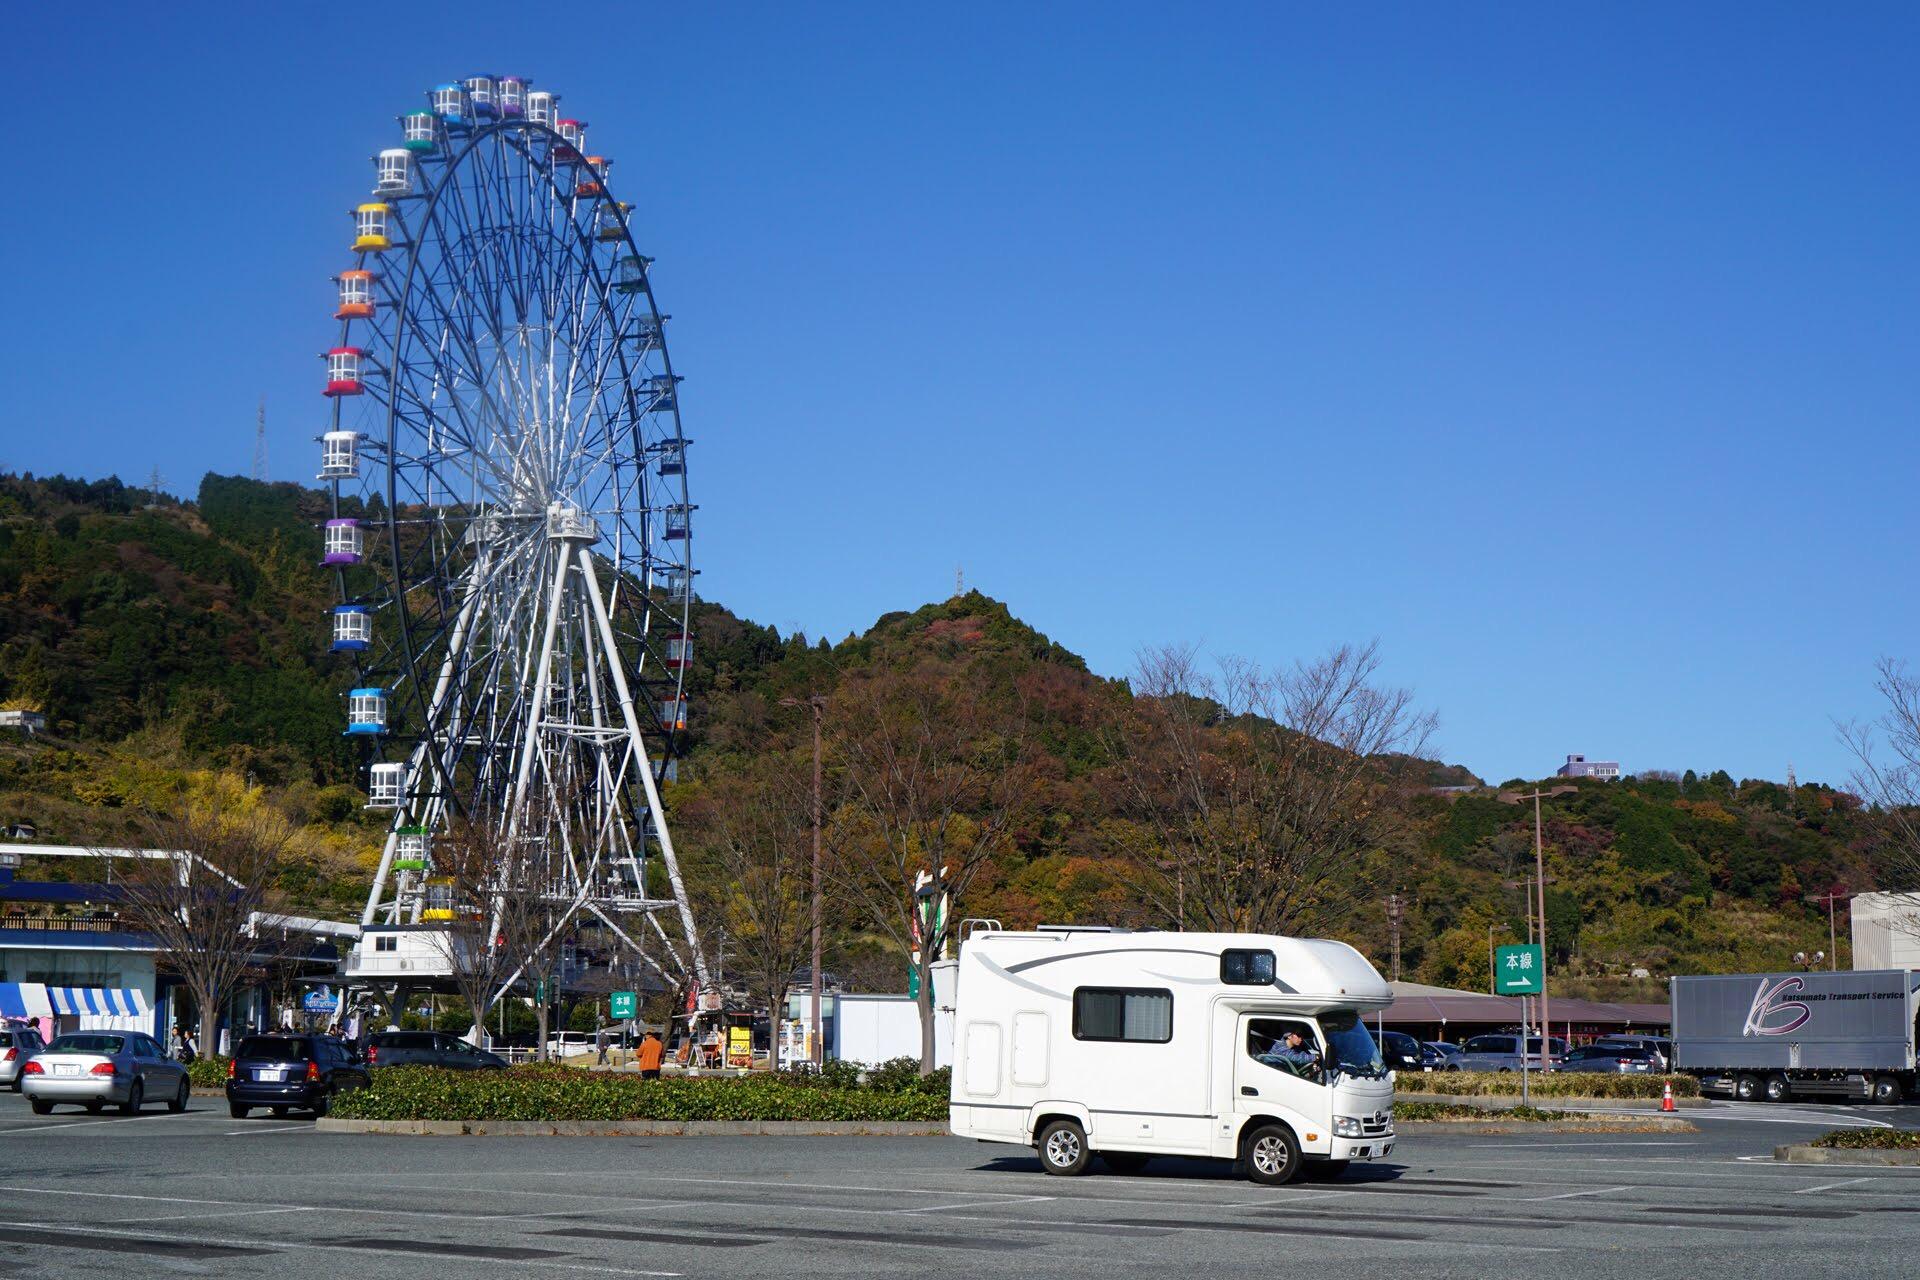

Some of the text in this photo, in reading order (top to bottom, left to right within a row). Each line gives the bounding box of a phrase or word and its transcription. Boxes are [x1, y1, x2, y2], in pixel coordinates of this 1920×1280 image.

[1506, 952, 1533, 970] 本線
[1782, 991, 1905, 1002] Katsumata Transport Service
